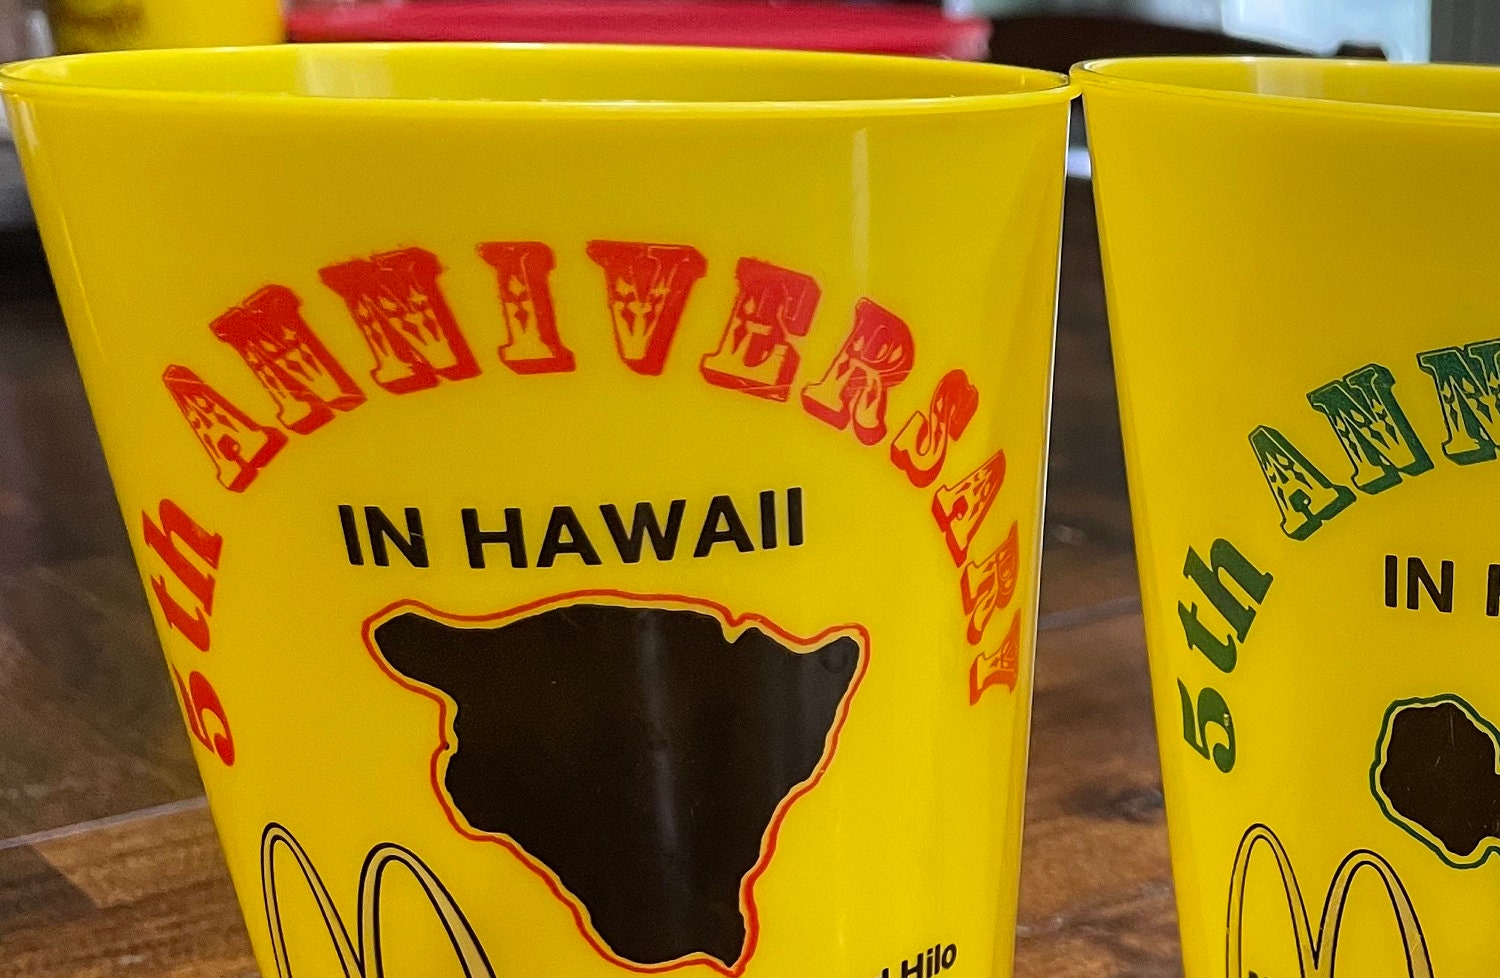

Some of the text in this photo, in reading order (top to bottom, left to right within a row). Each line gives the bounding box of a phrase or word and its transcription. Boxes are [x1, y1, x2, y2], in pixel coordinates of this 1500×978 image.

[141, 239, 1022, 767] 5th ANNIVERSARY
[337, 486, 805, 570] IN HAWAII
[1177, 535, 1274, 774] 5th
[1384, 554, 1455, 614] IN
